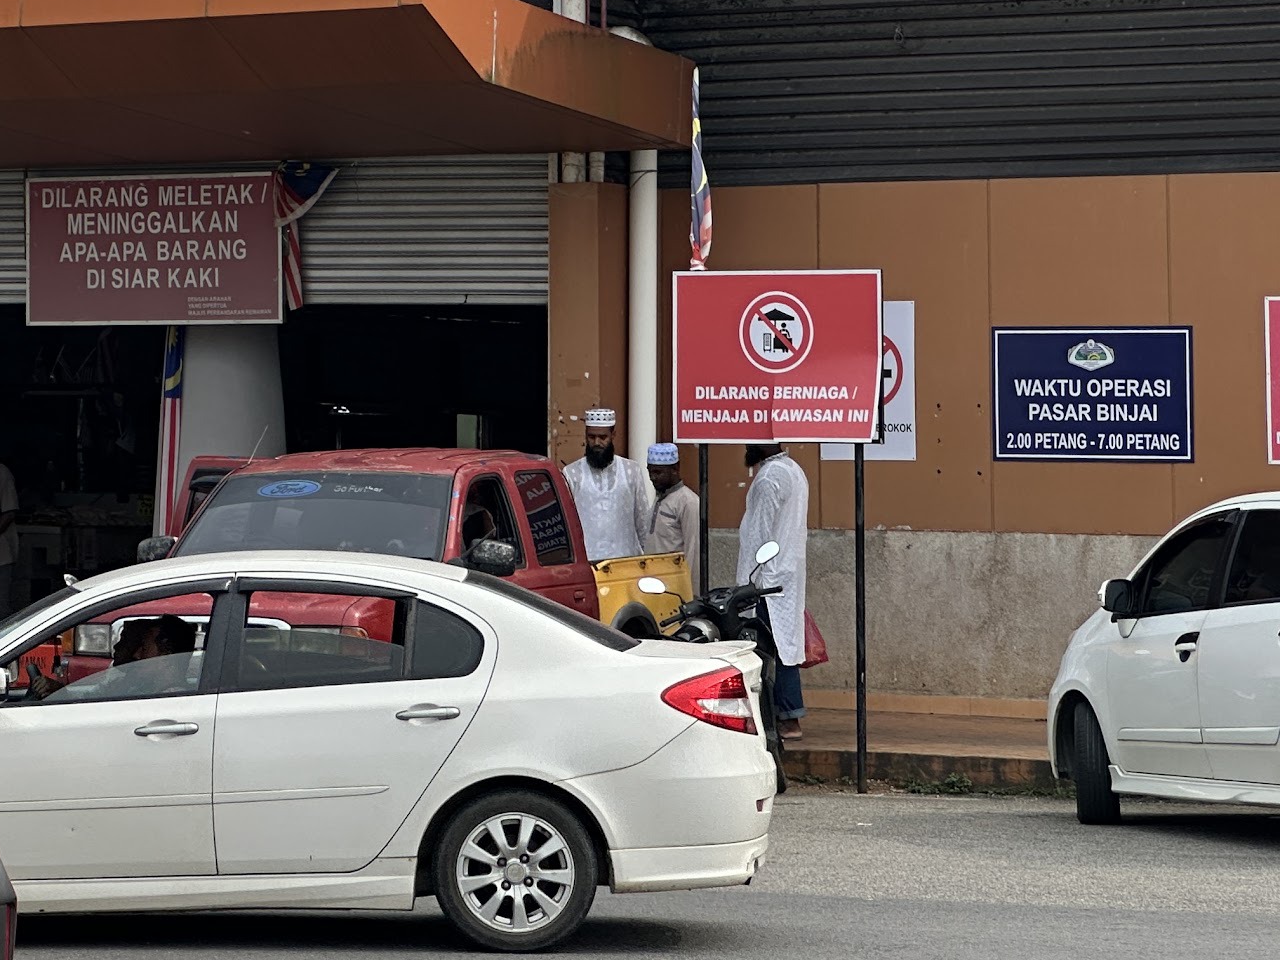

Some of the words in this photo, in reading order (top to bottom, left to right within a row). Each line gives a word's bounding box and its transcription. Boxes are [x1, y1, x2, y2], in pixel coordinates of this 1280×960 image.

[41, 187, 149, 208] DILARANG
[158, 184, 254, 206] MELETAK
[67, 210, 238, 235] MENINGGALKAN
[59, 241, 148, 263] APA-APA
[156, 239, 247, 261] BARANG
[87, 268, 105, 289] DI
[111, 268, 160, 289] SIAR
[167, 267, 219, 288] KAKI
[695, 386, 769, 400] DILARANG
[773, 386, 849, 400] BERNIAGA
[1014, 379, 1081, 397] WAKTU
[1087, 379, 1171, 397] OPERASI
[681, 409, 750, 423] MENJAJA
[753, 410, 768, 423] DI
[771, 409, 843, 423] KAWASAN
[848, 409, 869, 423] INI
[1028, 403, 1092, 421] PASAR
[1096, 404, 1158, 422] BINJAI
[1007, 433, 1032, 449] 2.00
[1035, 433, 1087, 450] PETANG
[1098, 434, 1123, 450] 7.00
[1126, 434, 1180, 450] PETANG
[271, 483, 308, 494] Ford
